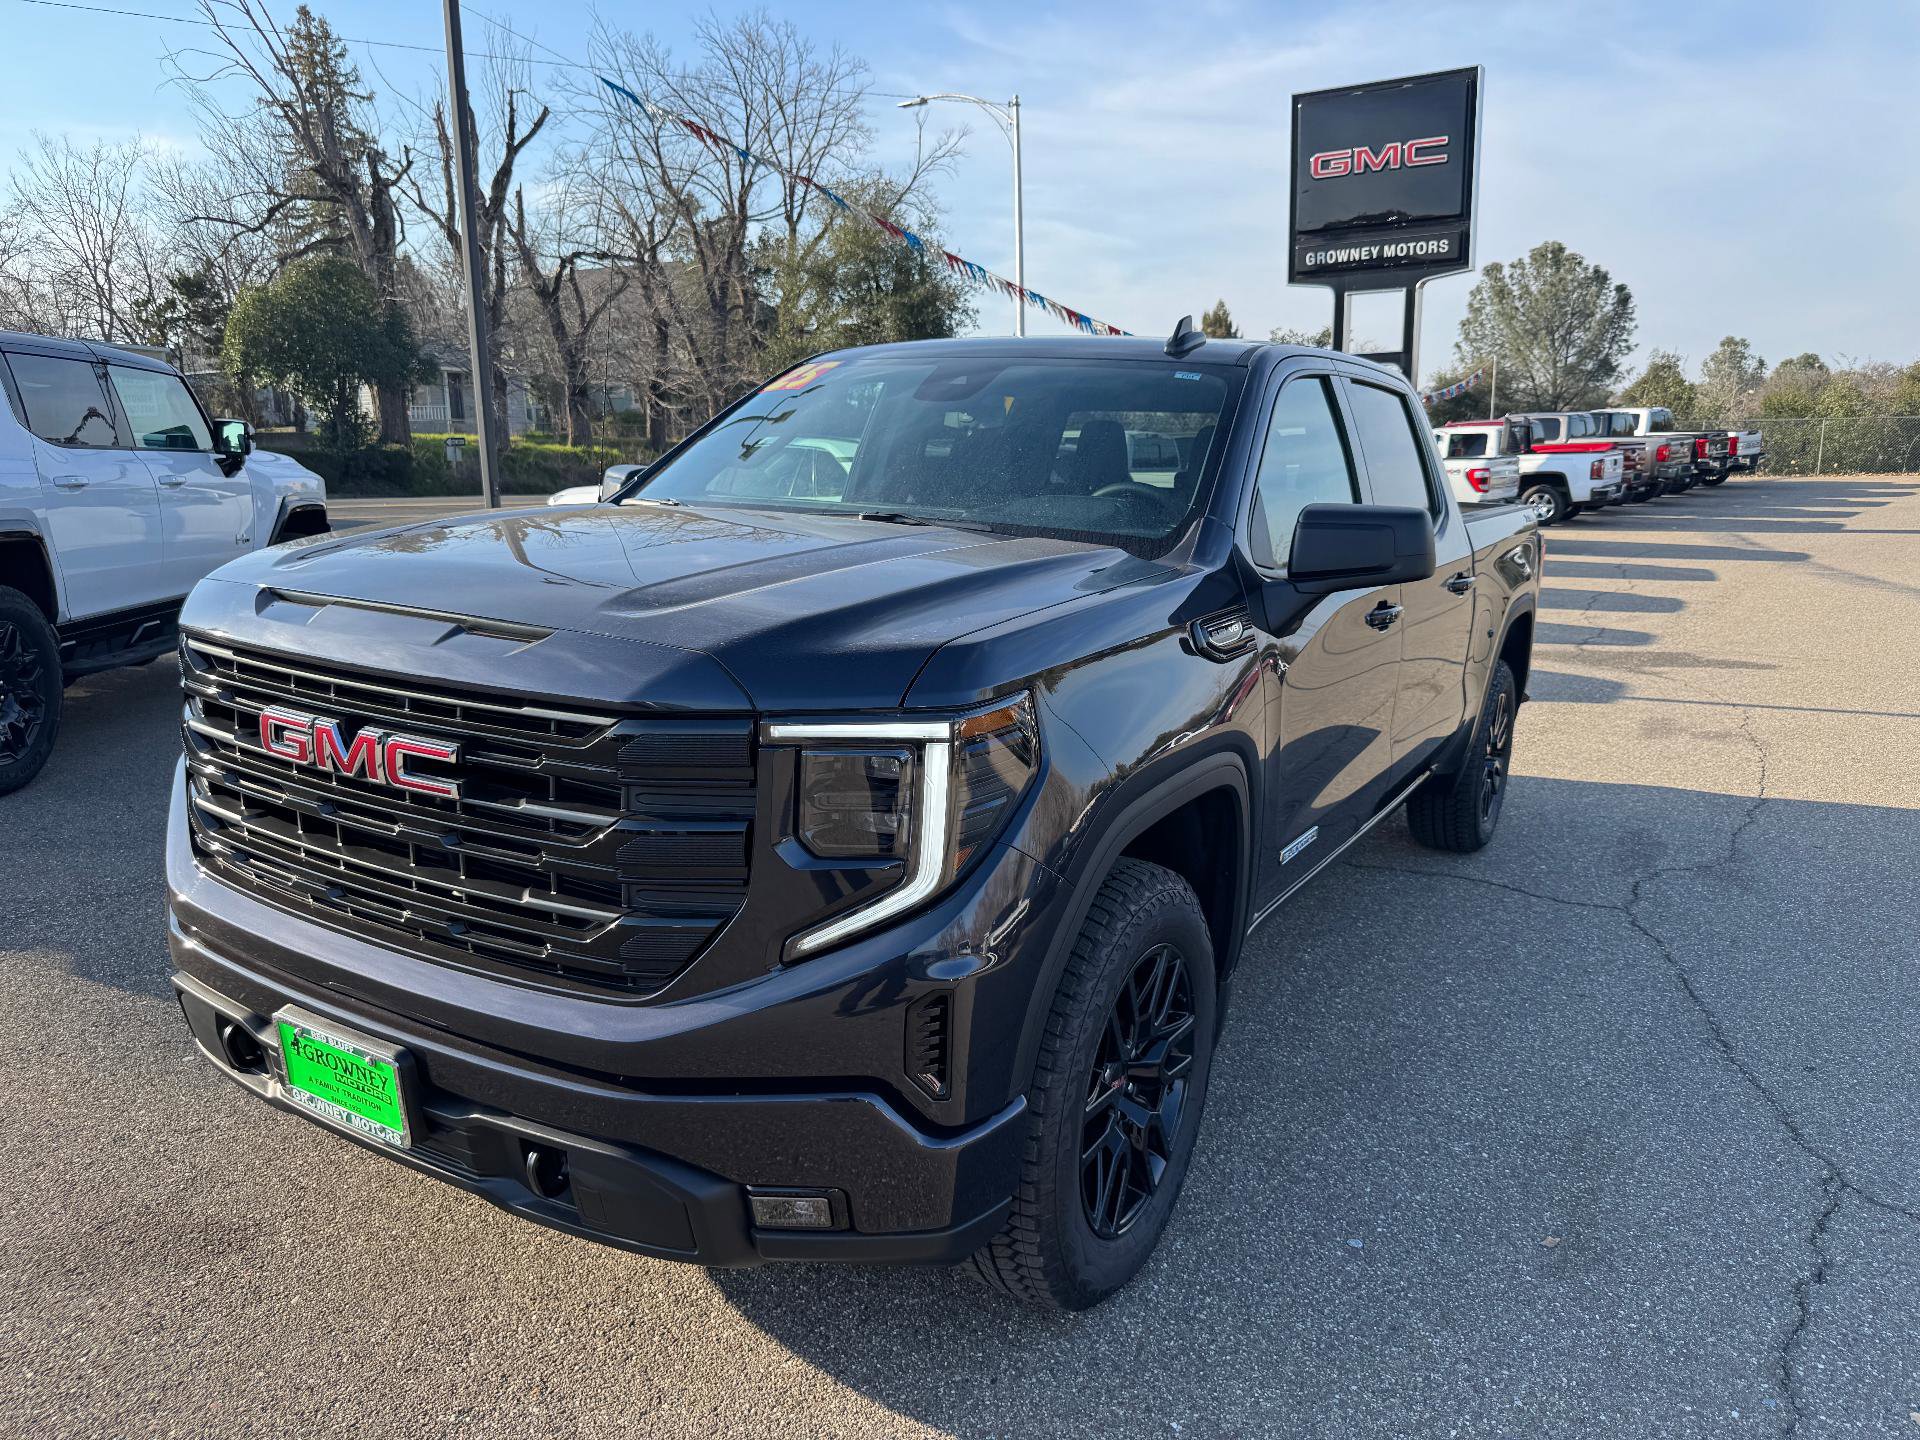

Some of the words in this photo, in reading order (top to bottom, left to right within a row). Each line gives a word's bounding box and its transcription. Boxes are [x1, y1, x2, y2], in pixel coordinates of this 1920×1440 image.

[1310, 135, 1449, 179] GMC
[1305, 245, 1380, 266] GROWNEY
[1383, 239, 1449, 258] MOTORS
[260, 705, 461, 800] GMC
[328, 1037, 354, 1053] BLUFF
[303, 1043, 388, 1092] GROWNEY
[308, 1075, 314, 1083] A
[315, 1080, 340, 1094] FAMILY
[341, 1089, 382, 1112] TRADITION
[336, 1074, 391, 1104] MOTORS
[351, 1115, 402, 1145] MOTORS
